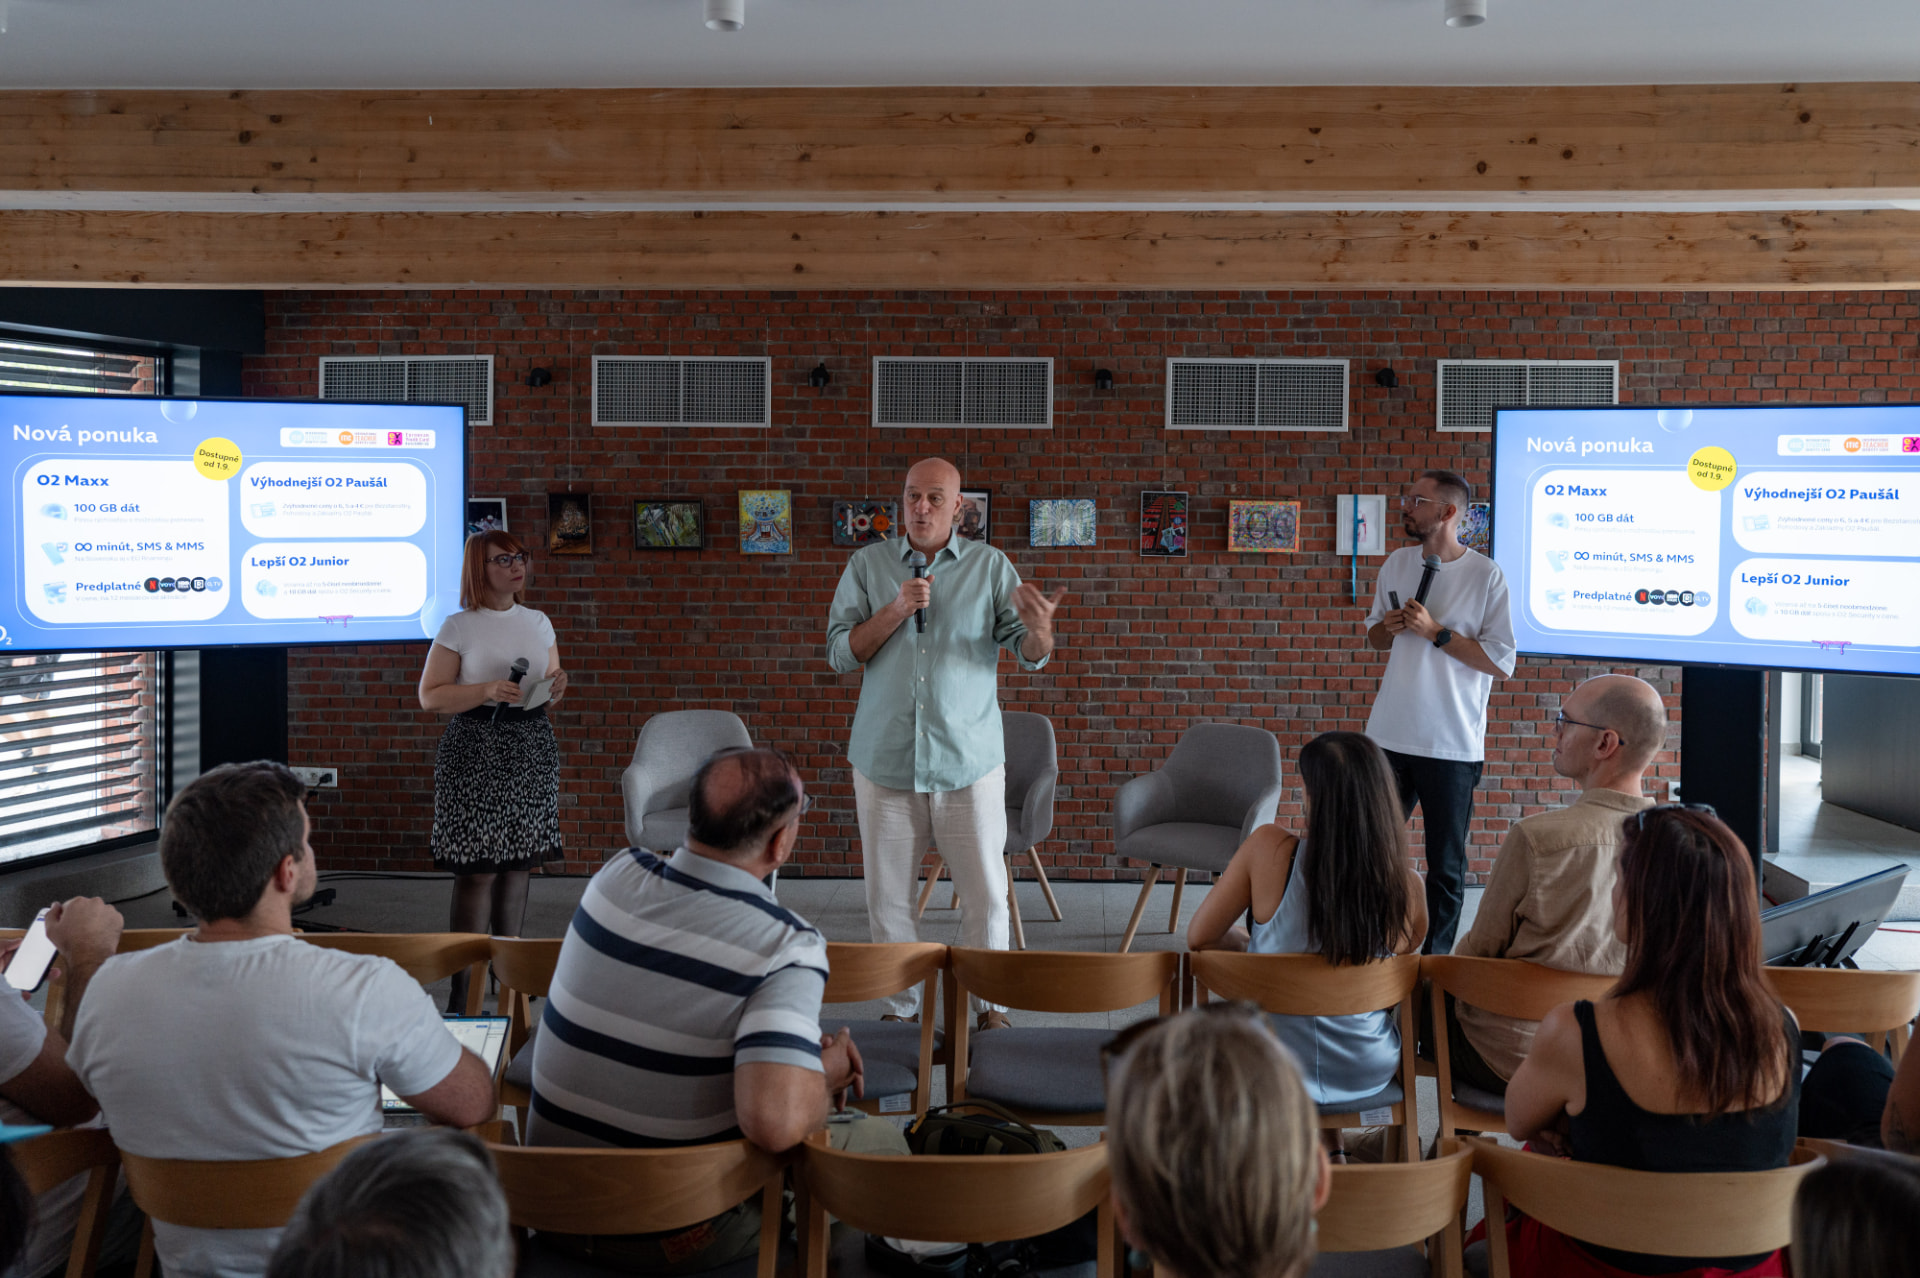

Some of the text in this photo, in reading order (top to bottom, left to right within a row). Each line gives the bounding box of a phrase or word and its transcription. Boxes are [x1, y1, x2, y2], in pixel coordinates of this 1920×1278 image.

[14, 425, 158, 446] Nová ponuka
[1527, 437, 1654, 456] Nová ponuka
[199, 449, 239, 463] Dostupné
[204, 460, 230, 471] od 1.9.
[1692, 459, 1733, 473] Dostupné
[37, 475, 109, 486] O2 Maxx
[1697, 469, 1723, 481] od 1.9.
[251, 476, 387, 490] Výhodnejší O2 Paušál
[1545, 485, 1607, 496] O2 Maxx
[1744, 487, 1899, 502] Výhodnejší O2 Paušál
[74, 503, 140, 513] 100 GB dát
[1575, 513, 1634, 523] 100 GB dát
[97, 541, 134, 552] minút,
[137, 542, 162, 551] SMS
[165, 542, 173, 551] &
[176, 542, 204, 551] MMS
[251, 556, 349, 569] Lepší O2 Junior
[1593, 552, 1626, 563] minút,
[1630, 553, 1653, 562] SMS
[1656, 554, 1663, 563] &
[1667, 554, 1694, 564] MMS
[1741, 573, 1850, 586] Lepší O2 Junior
[76, 581, 141, 593] Predplatné
[1573, 591, 1632, 602] Predplatné
